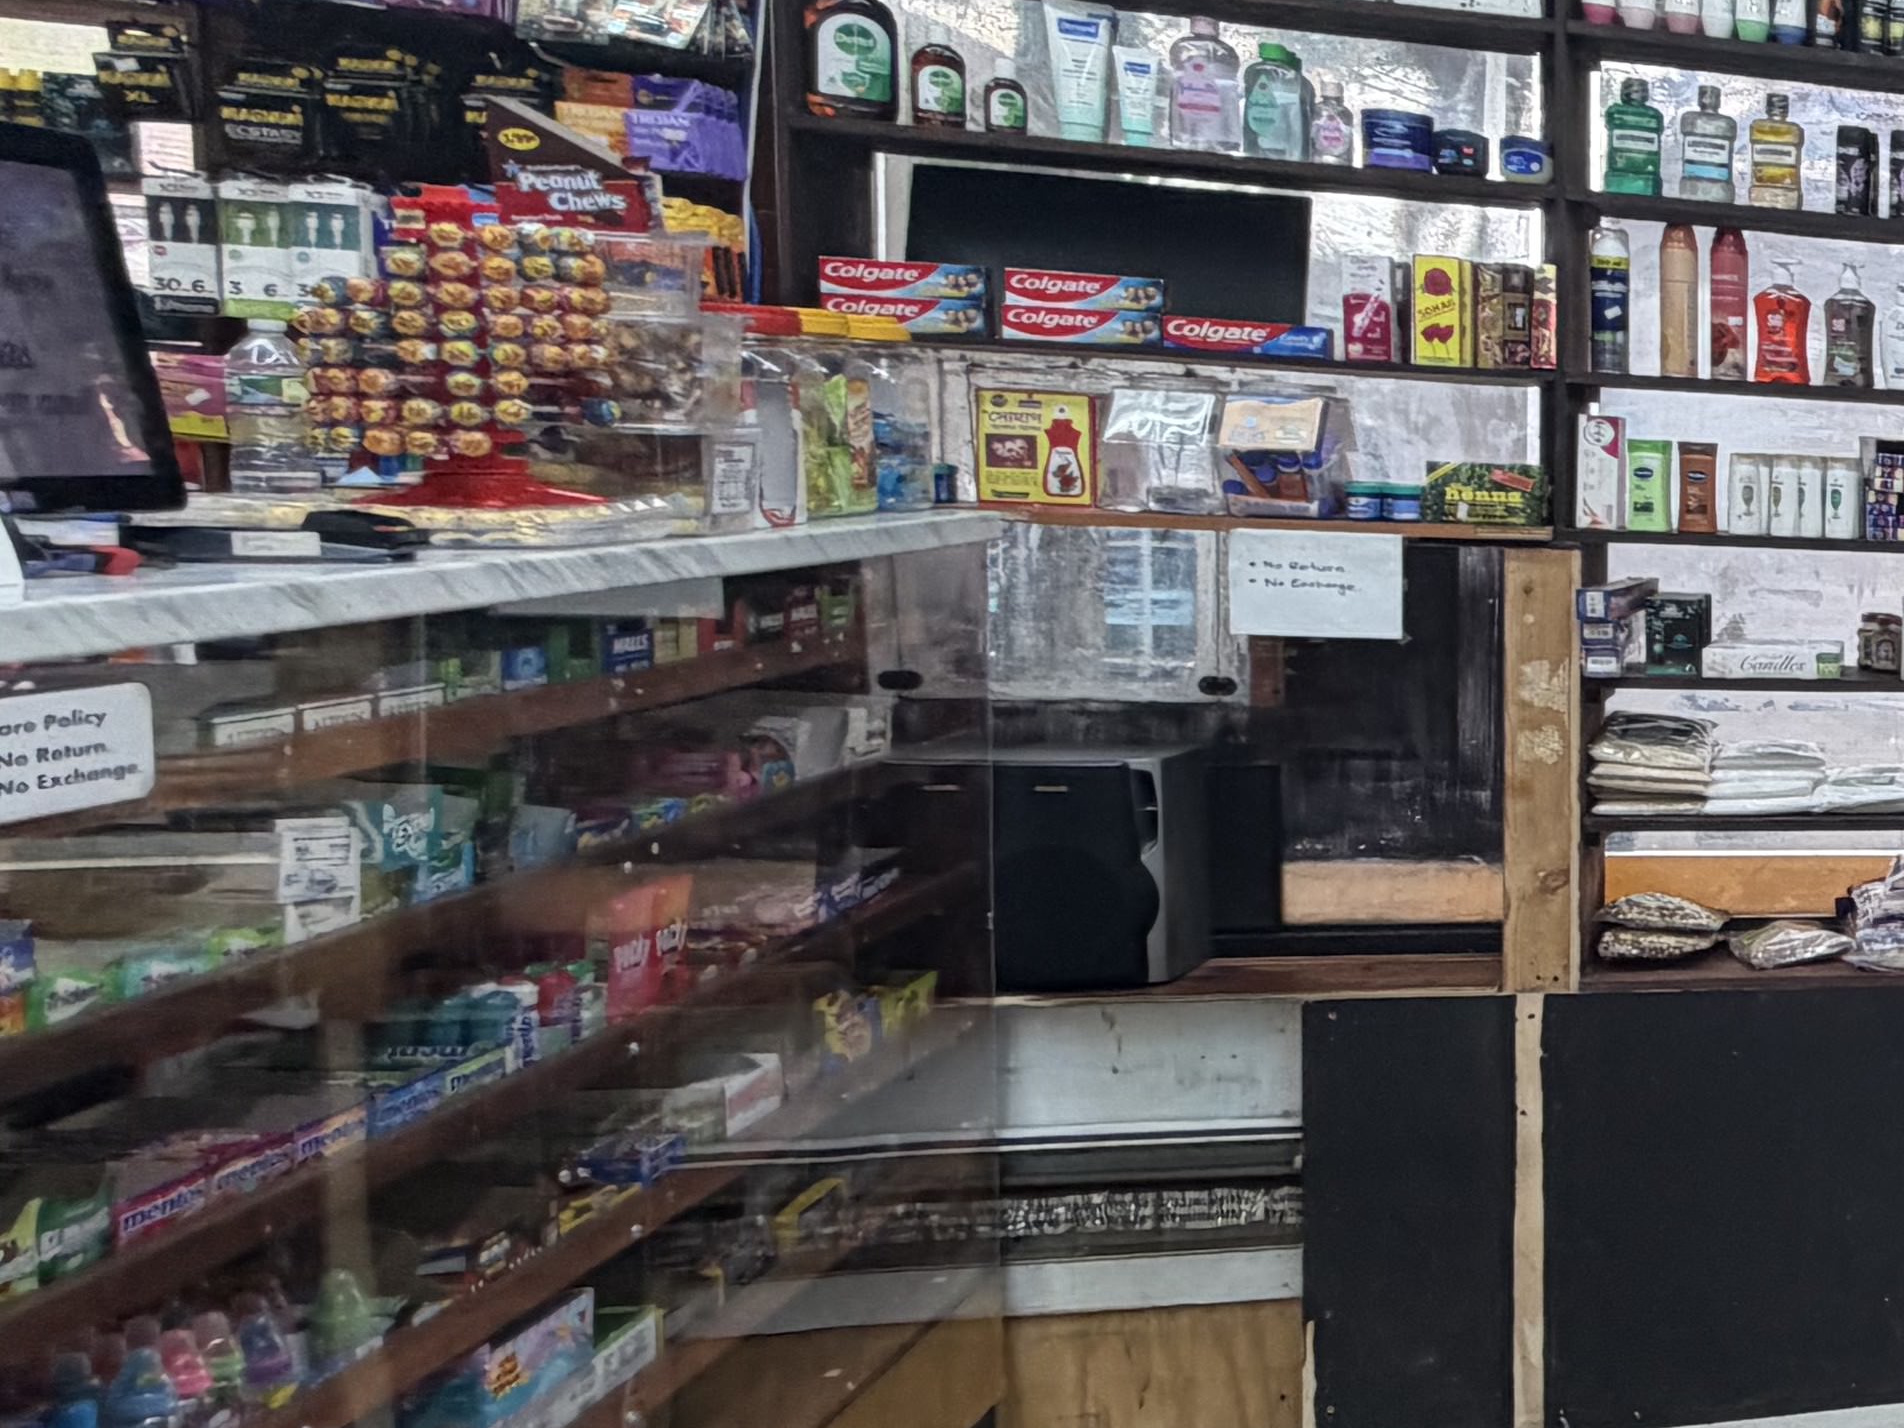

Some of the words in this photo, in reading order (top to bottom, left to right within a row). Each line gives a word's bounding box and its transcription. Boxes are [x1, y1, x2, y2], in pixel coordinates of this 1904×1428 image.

[631, 112, 692, 128] TROJAN
[516, 170, 602, 192] Peanut
[548, 190, 626, 212] Chews
[824, 260, 922, 285] Colgate
[1009, 273, 1102, 295] Colgate
[1007, 308, 1101, 329] Colgate
[1165, 317, 1272, 344] Colgate
[1263, 560, 1285, 572] No
[1287, 560, 1346, 573] Return
[1263, 577, 1286, 590] No
[1738, 652, 1808, 674] Candles
[43, 709, 107, 731] Policy
[0, 752, 28, 768] No
[36, 742, 108, 764] Return
[0, 780, 30, 796] No
[36, 763, 139, 790] Exchange
[121, 1186, 201, 1233] mentos
